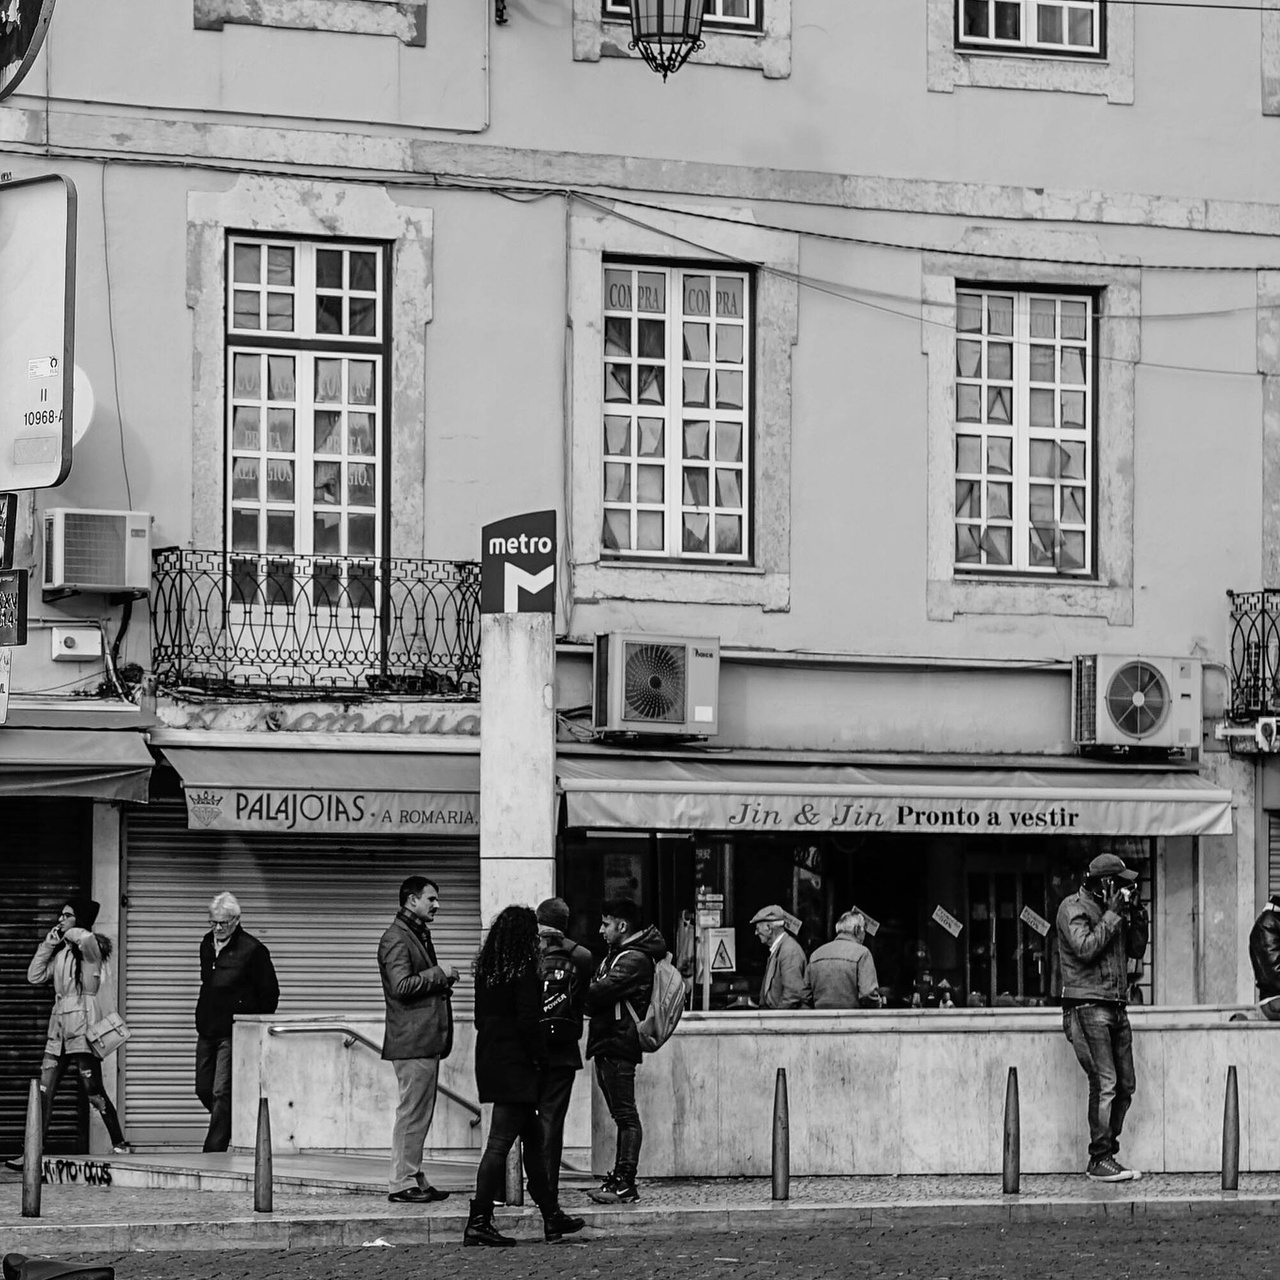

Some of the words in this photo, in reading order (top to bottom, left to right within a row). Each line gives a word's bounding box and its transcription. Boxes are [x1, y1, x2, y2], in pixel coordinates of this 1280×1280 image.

[245, 431, 282, 451] PRTA
[325, 436, 363, 455] PRTA
[489, 533, 552, 555] metro
[381, 809, 393, 824] A
[728, 802, 782, 825] Jin
[793, 803, 820, 825] &
[830, 804, 885, 827] Jin
[896, 804, 980, 827] Pronto
[987, 810, 1001, 827] a
[1009, 806, 1079, 828] vestir
